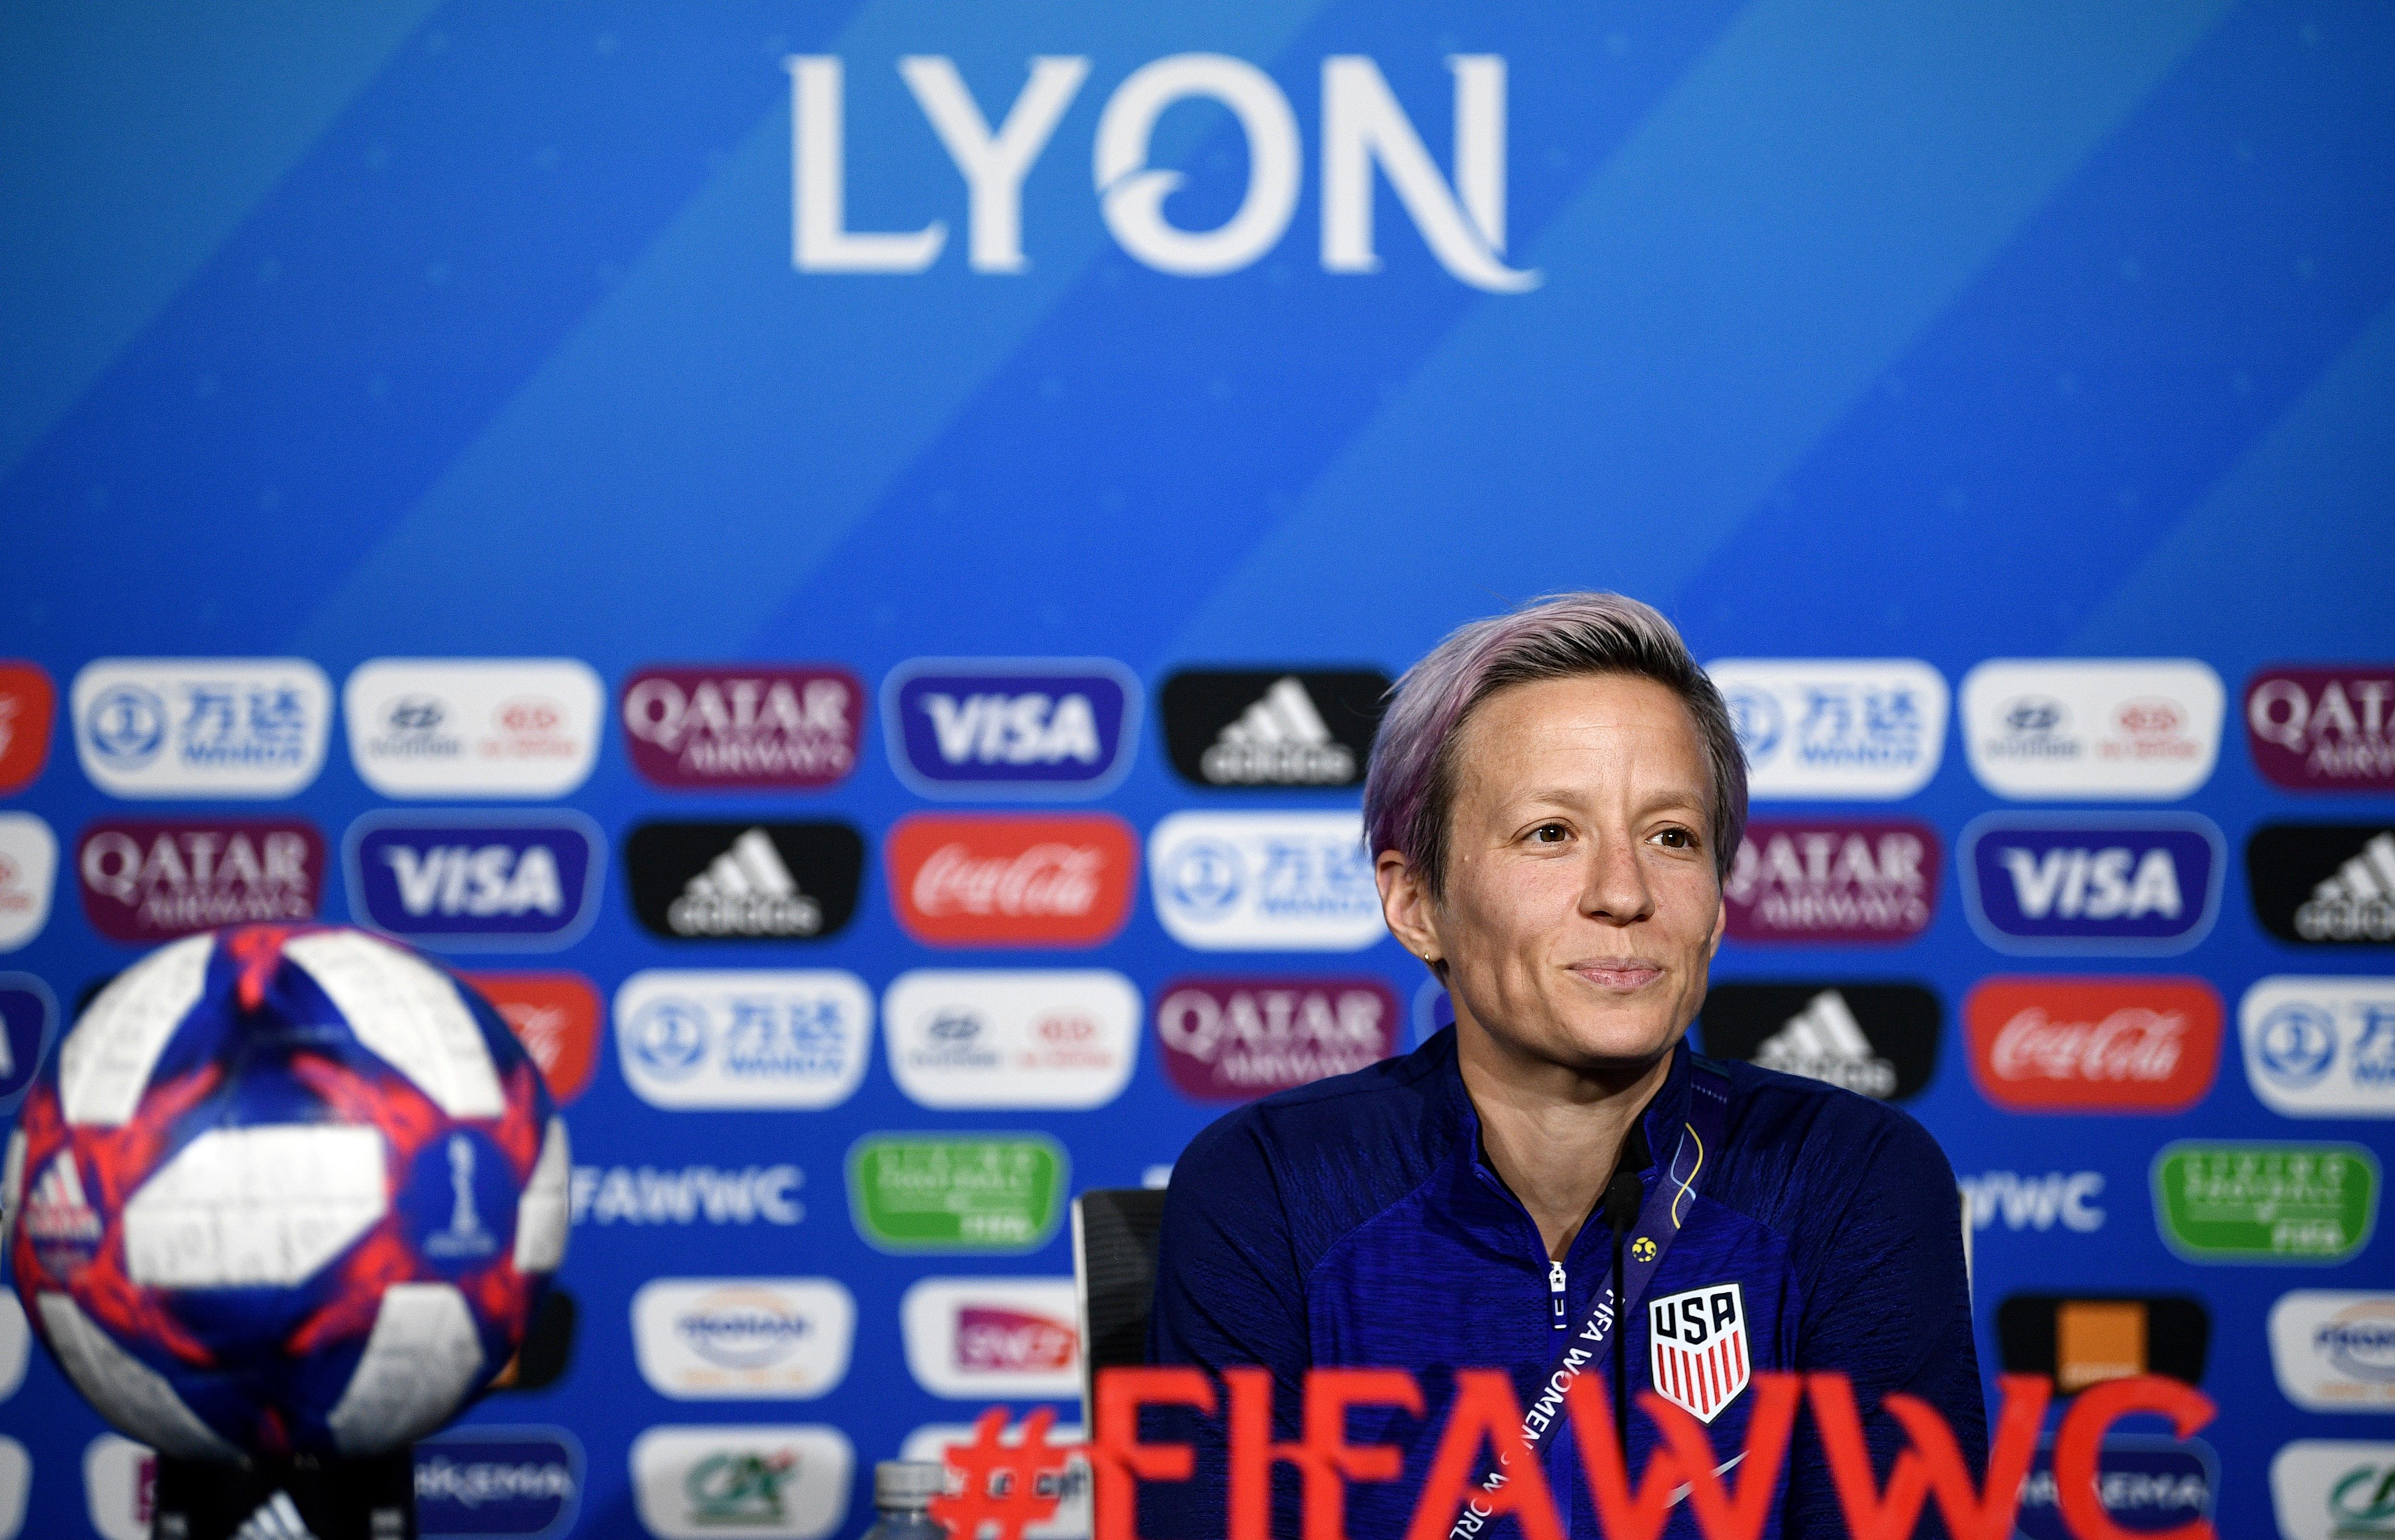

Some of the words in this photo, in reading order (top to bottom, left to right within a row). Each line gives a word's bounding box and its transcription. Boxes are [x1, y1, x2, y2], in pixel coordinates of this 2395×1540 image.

[782, 50, 1542, 293] LYON
[624, 679, 850, 753] QATAR
[921, 694, 1100, 765] VISA
[1200, 741, 1356, 785] adidas
[81, 831, 309, 904] QATAR
[388, 845, 563, 917] VISA
[2002, 848, 2183, 920] VISA
[668, 893, 823, 936] adidas
[1158, 990, 1384, 1062] QATAR
[1656, 1292, 1735, 1345] USA
[927, 1367, 2219, 1540] #FIFAWWC
